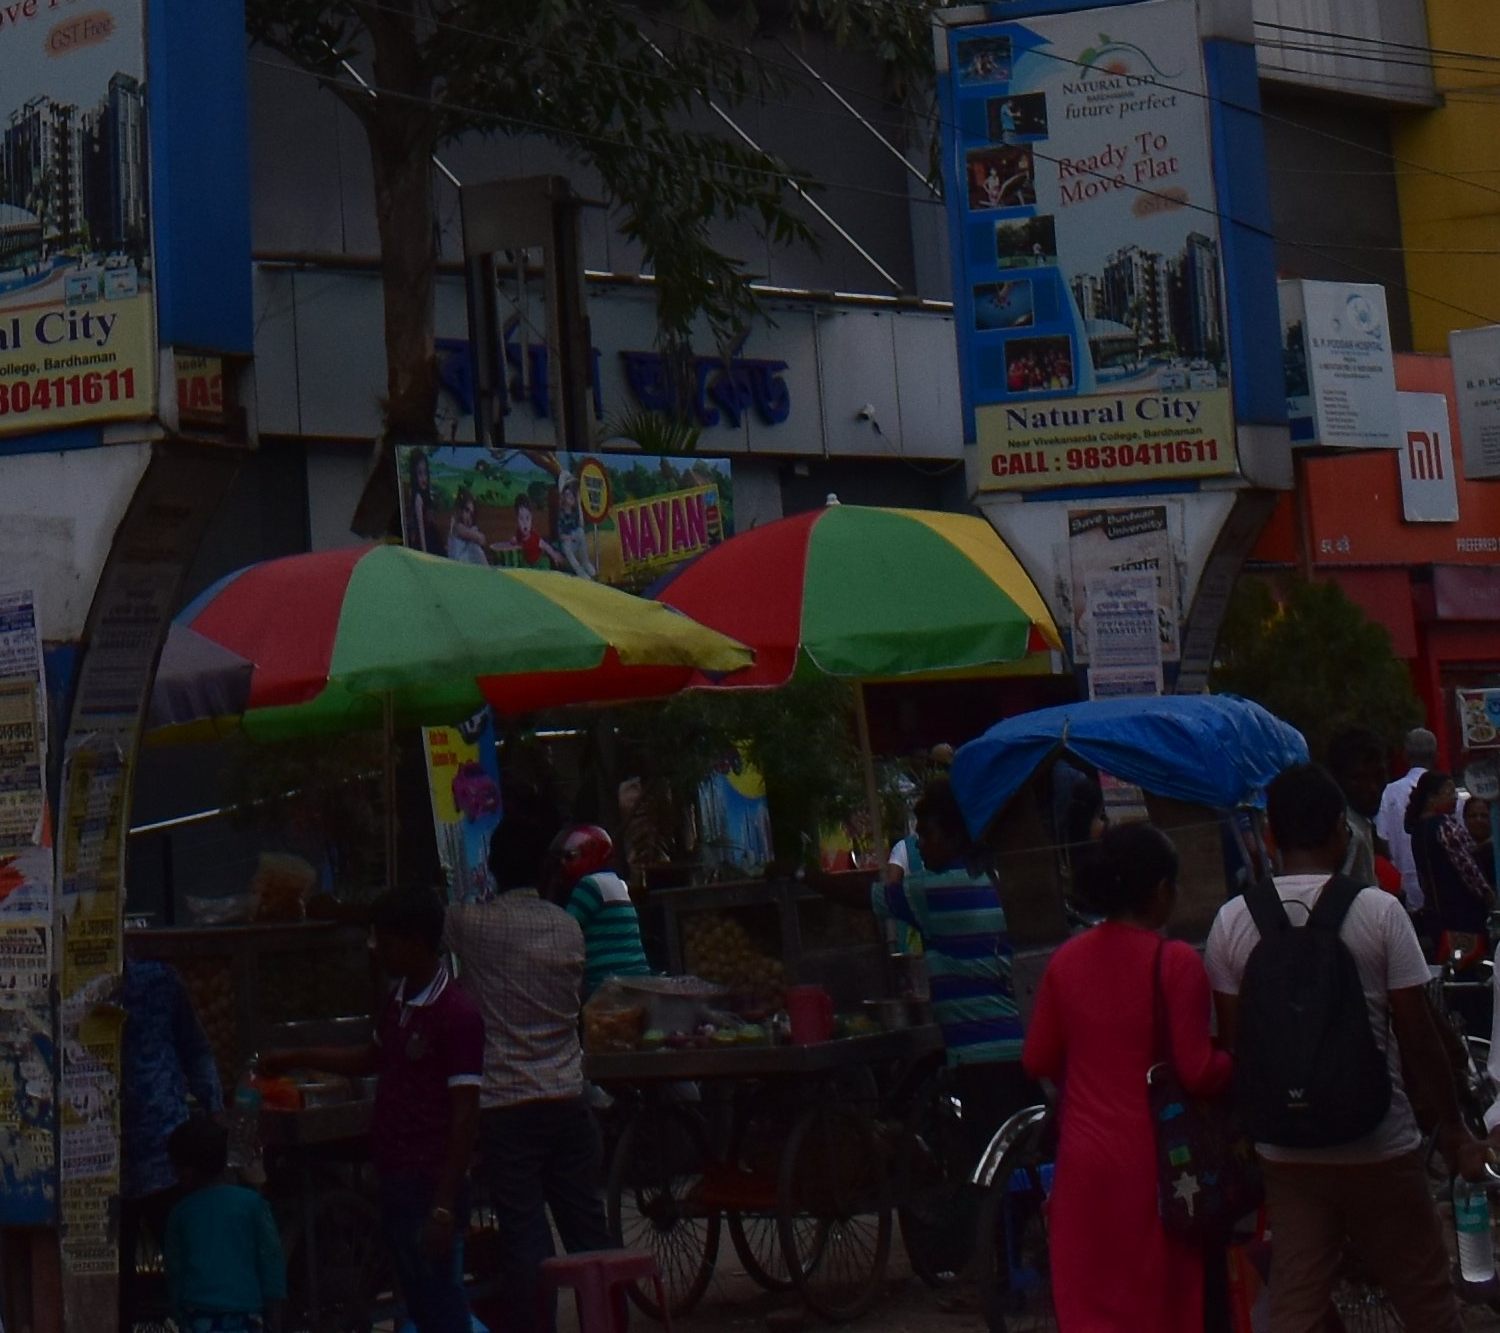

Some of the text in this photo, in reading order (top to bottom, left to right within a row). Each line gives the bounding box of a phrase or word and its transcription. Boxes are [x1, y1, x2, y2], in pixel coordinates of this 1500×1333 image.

[51, 18, 111, 51] GST Free
[1063, 78, 1122, 95] NATURAL
[1064, 93, 1177, 120] future perfect
[1058, 133, 1168, 180] Ready To
[1059, 156, 1178, 206] Move Flat
[35, 309, 118, 346] City
[44, 352, 117, 371] Bardhaman
[1006, 395, 1201, 430] Natural City
[1009, 438, 1030, 449] Near
[1033, 433, 1097, 446] Vivekananda
[1144, 426, 1203, 438] Bardhaman
[991, 439, 1218, 477] CALL 9830411611
[617, 492, 708, 565] NAYAN
[1107, 508, 1155, 524] Burdwan
[1109, 519, 1163, 535] University
[1456, 537, 1498, 552] PREFERRED
